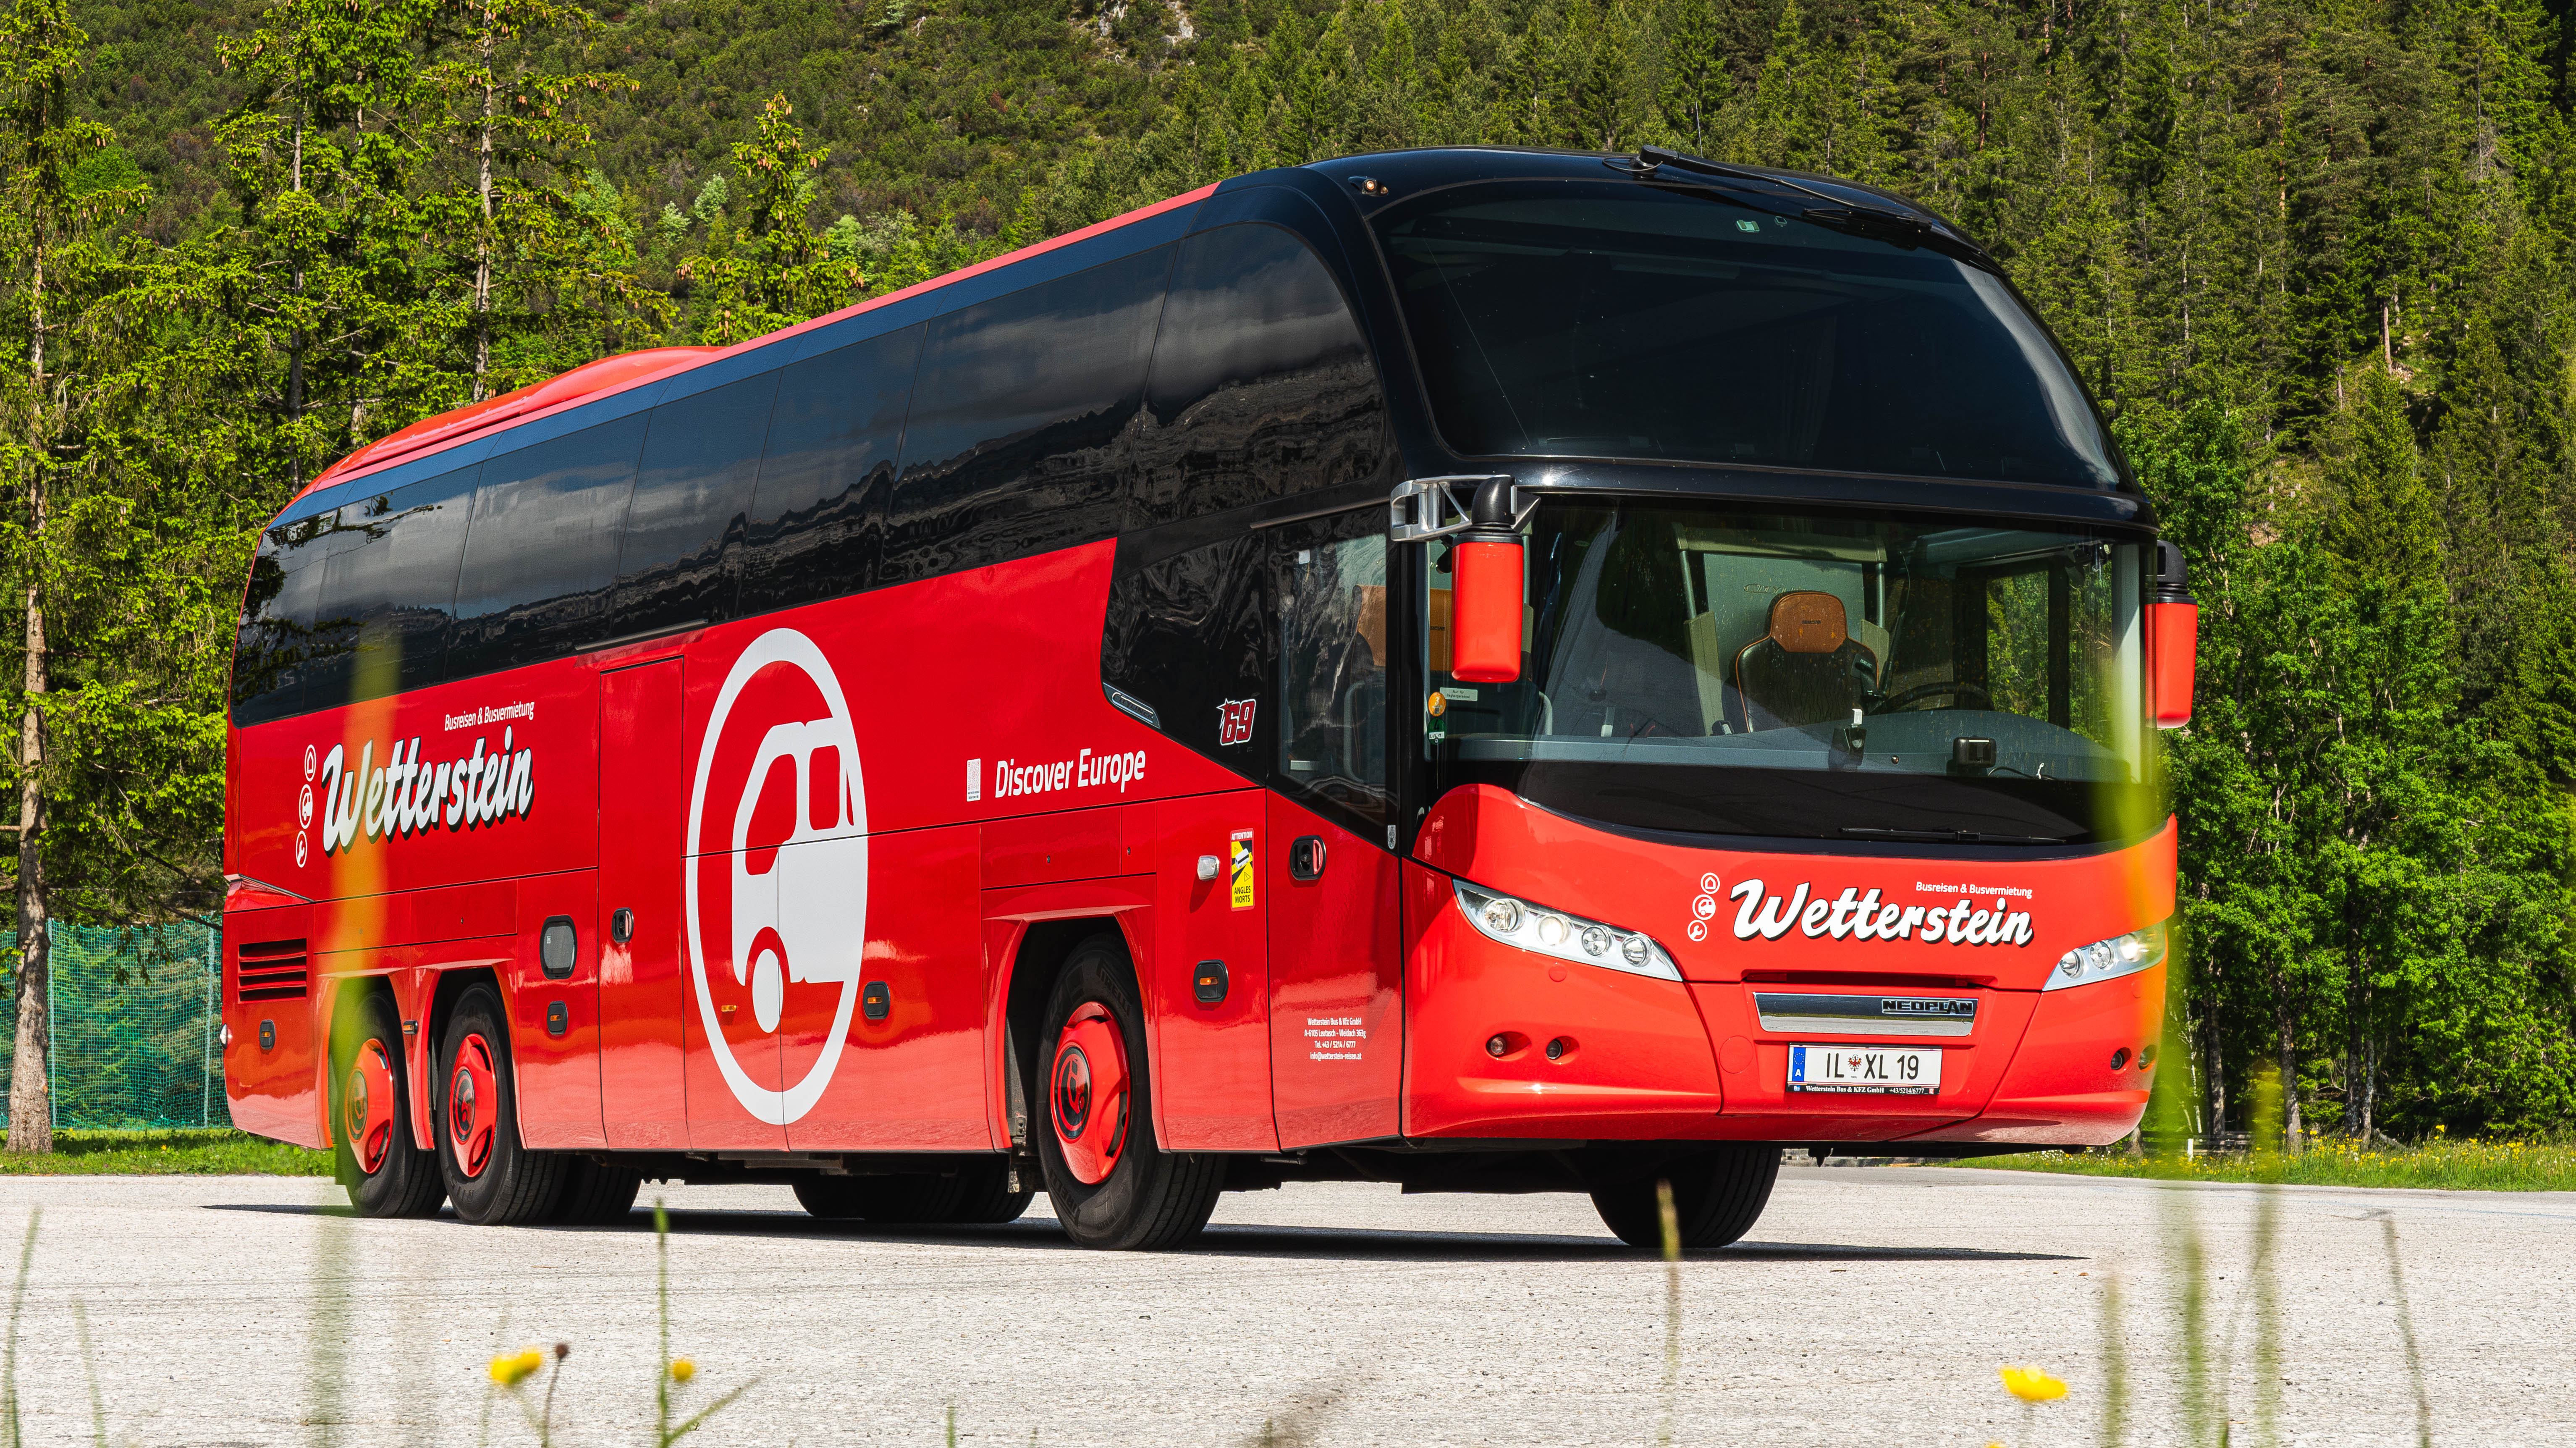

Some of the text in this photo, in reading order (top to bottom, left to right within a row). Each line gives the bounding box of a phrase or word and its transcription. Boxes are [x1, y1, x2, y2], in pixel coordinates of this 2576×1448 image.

[444, 700, 535, 731] Busreisen & Busvermietung
[1220, 698, 1256, 745] 69
[995, 748, 1146, 798] Discover Europe
[321, 724, 535, 858] Wetterstein
[1231, 831, 1253, 840] ATTENTION
[1234, 885, 1251, 895] ANGLES
[1916, 881, 2032, 899] Busreisen & Busvermietung
[1235, 895, 1250, 903] MORTS
[1730, 878, 2034, 948] Wetterstein
[1882, 999, 1973, 1015] NEOPLAN
[1338, 1017, 1342, 1026] &
[1310, 1051, 1362, 1062] info@wetterstein-reisen.at
[1795, 1068, 1801, 1077] A
[1827, 1053, 1919, 1080] IL XL 19
